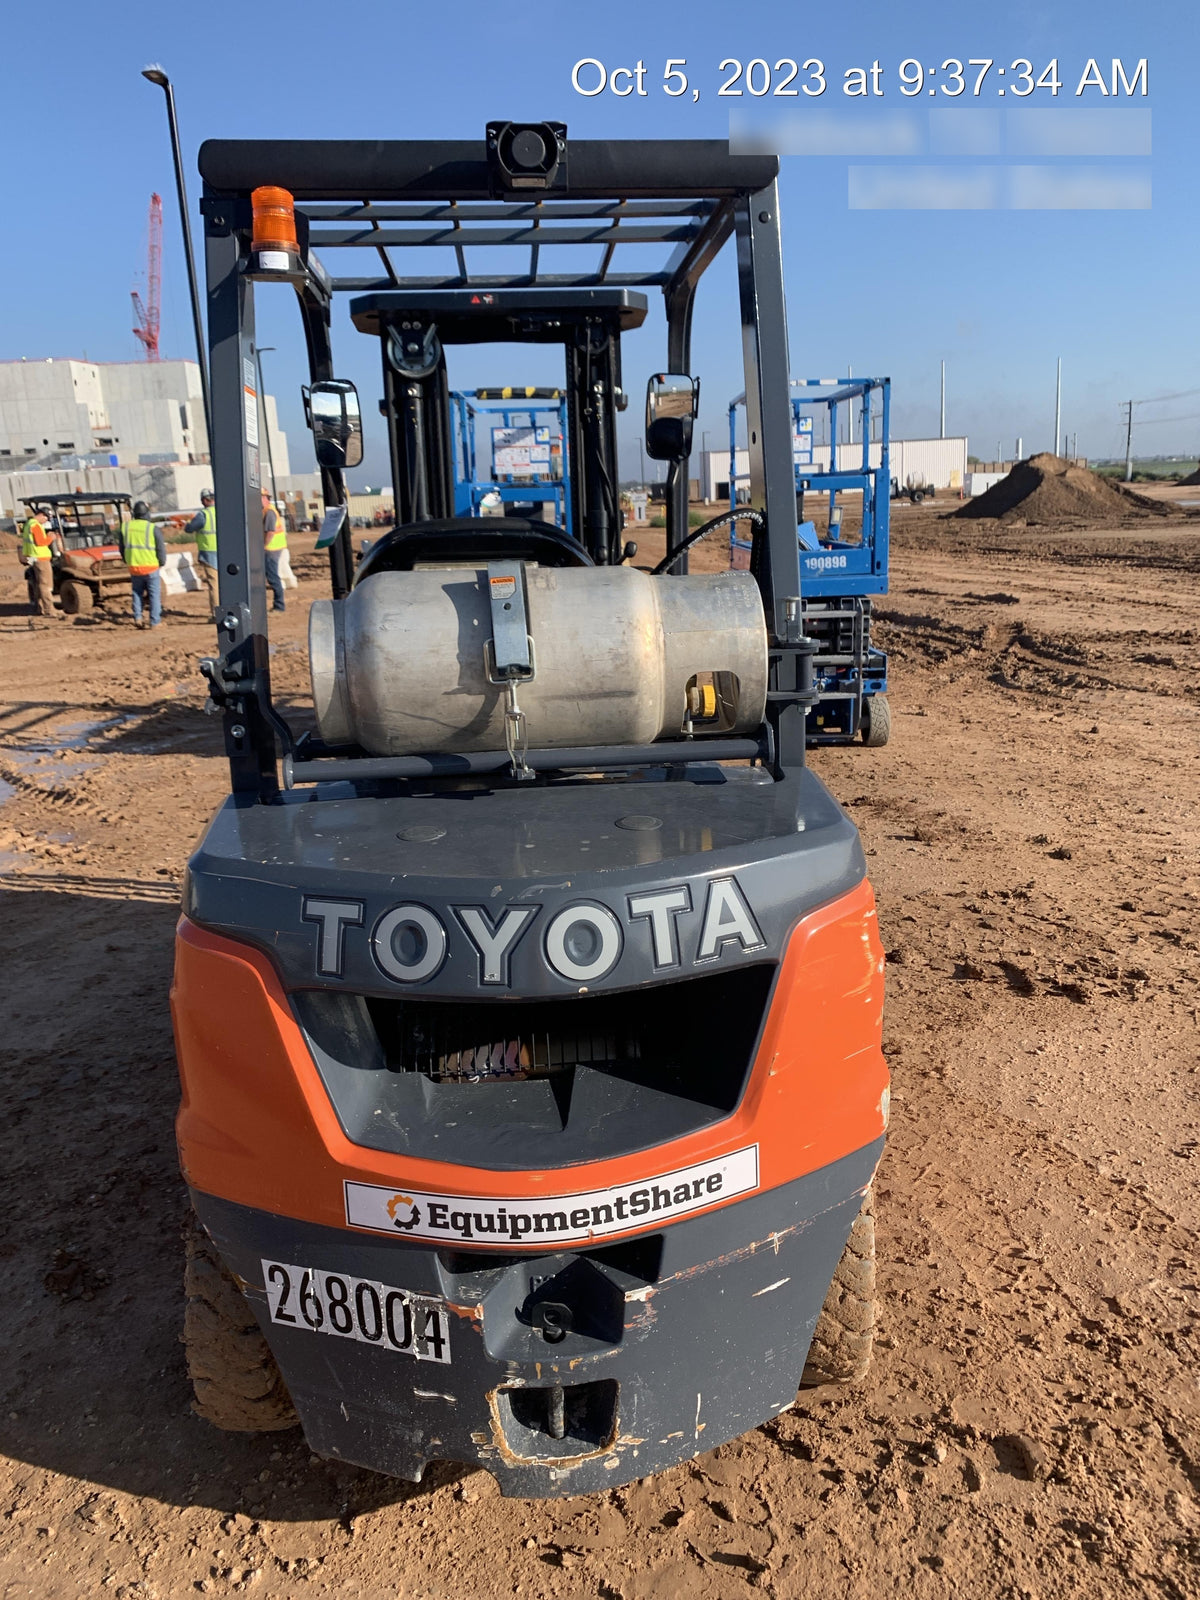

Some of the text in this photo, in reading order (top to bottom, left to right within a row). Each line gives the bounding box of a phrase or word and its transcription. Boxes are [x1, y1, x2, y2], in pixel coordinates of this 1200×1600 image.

[804, 555, 847, 569] 190898
[303, 877, 764, 982] TOYOTA
[426, 1170, 723, 1240] EquipmentShare
[268, 1264, 446, 1360] 268004
